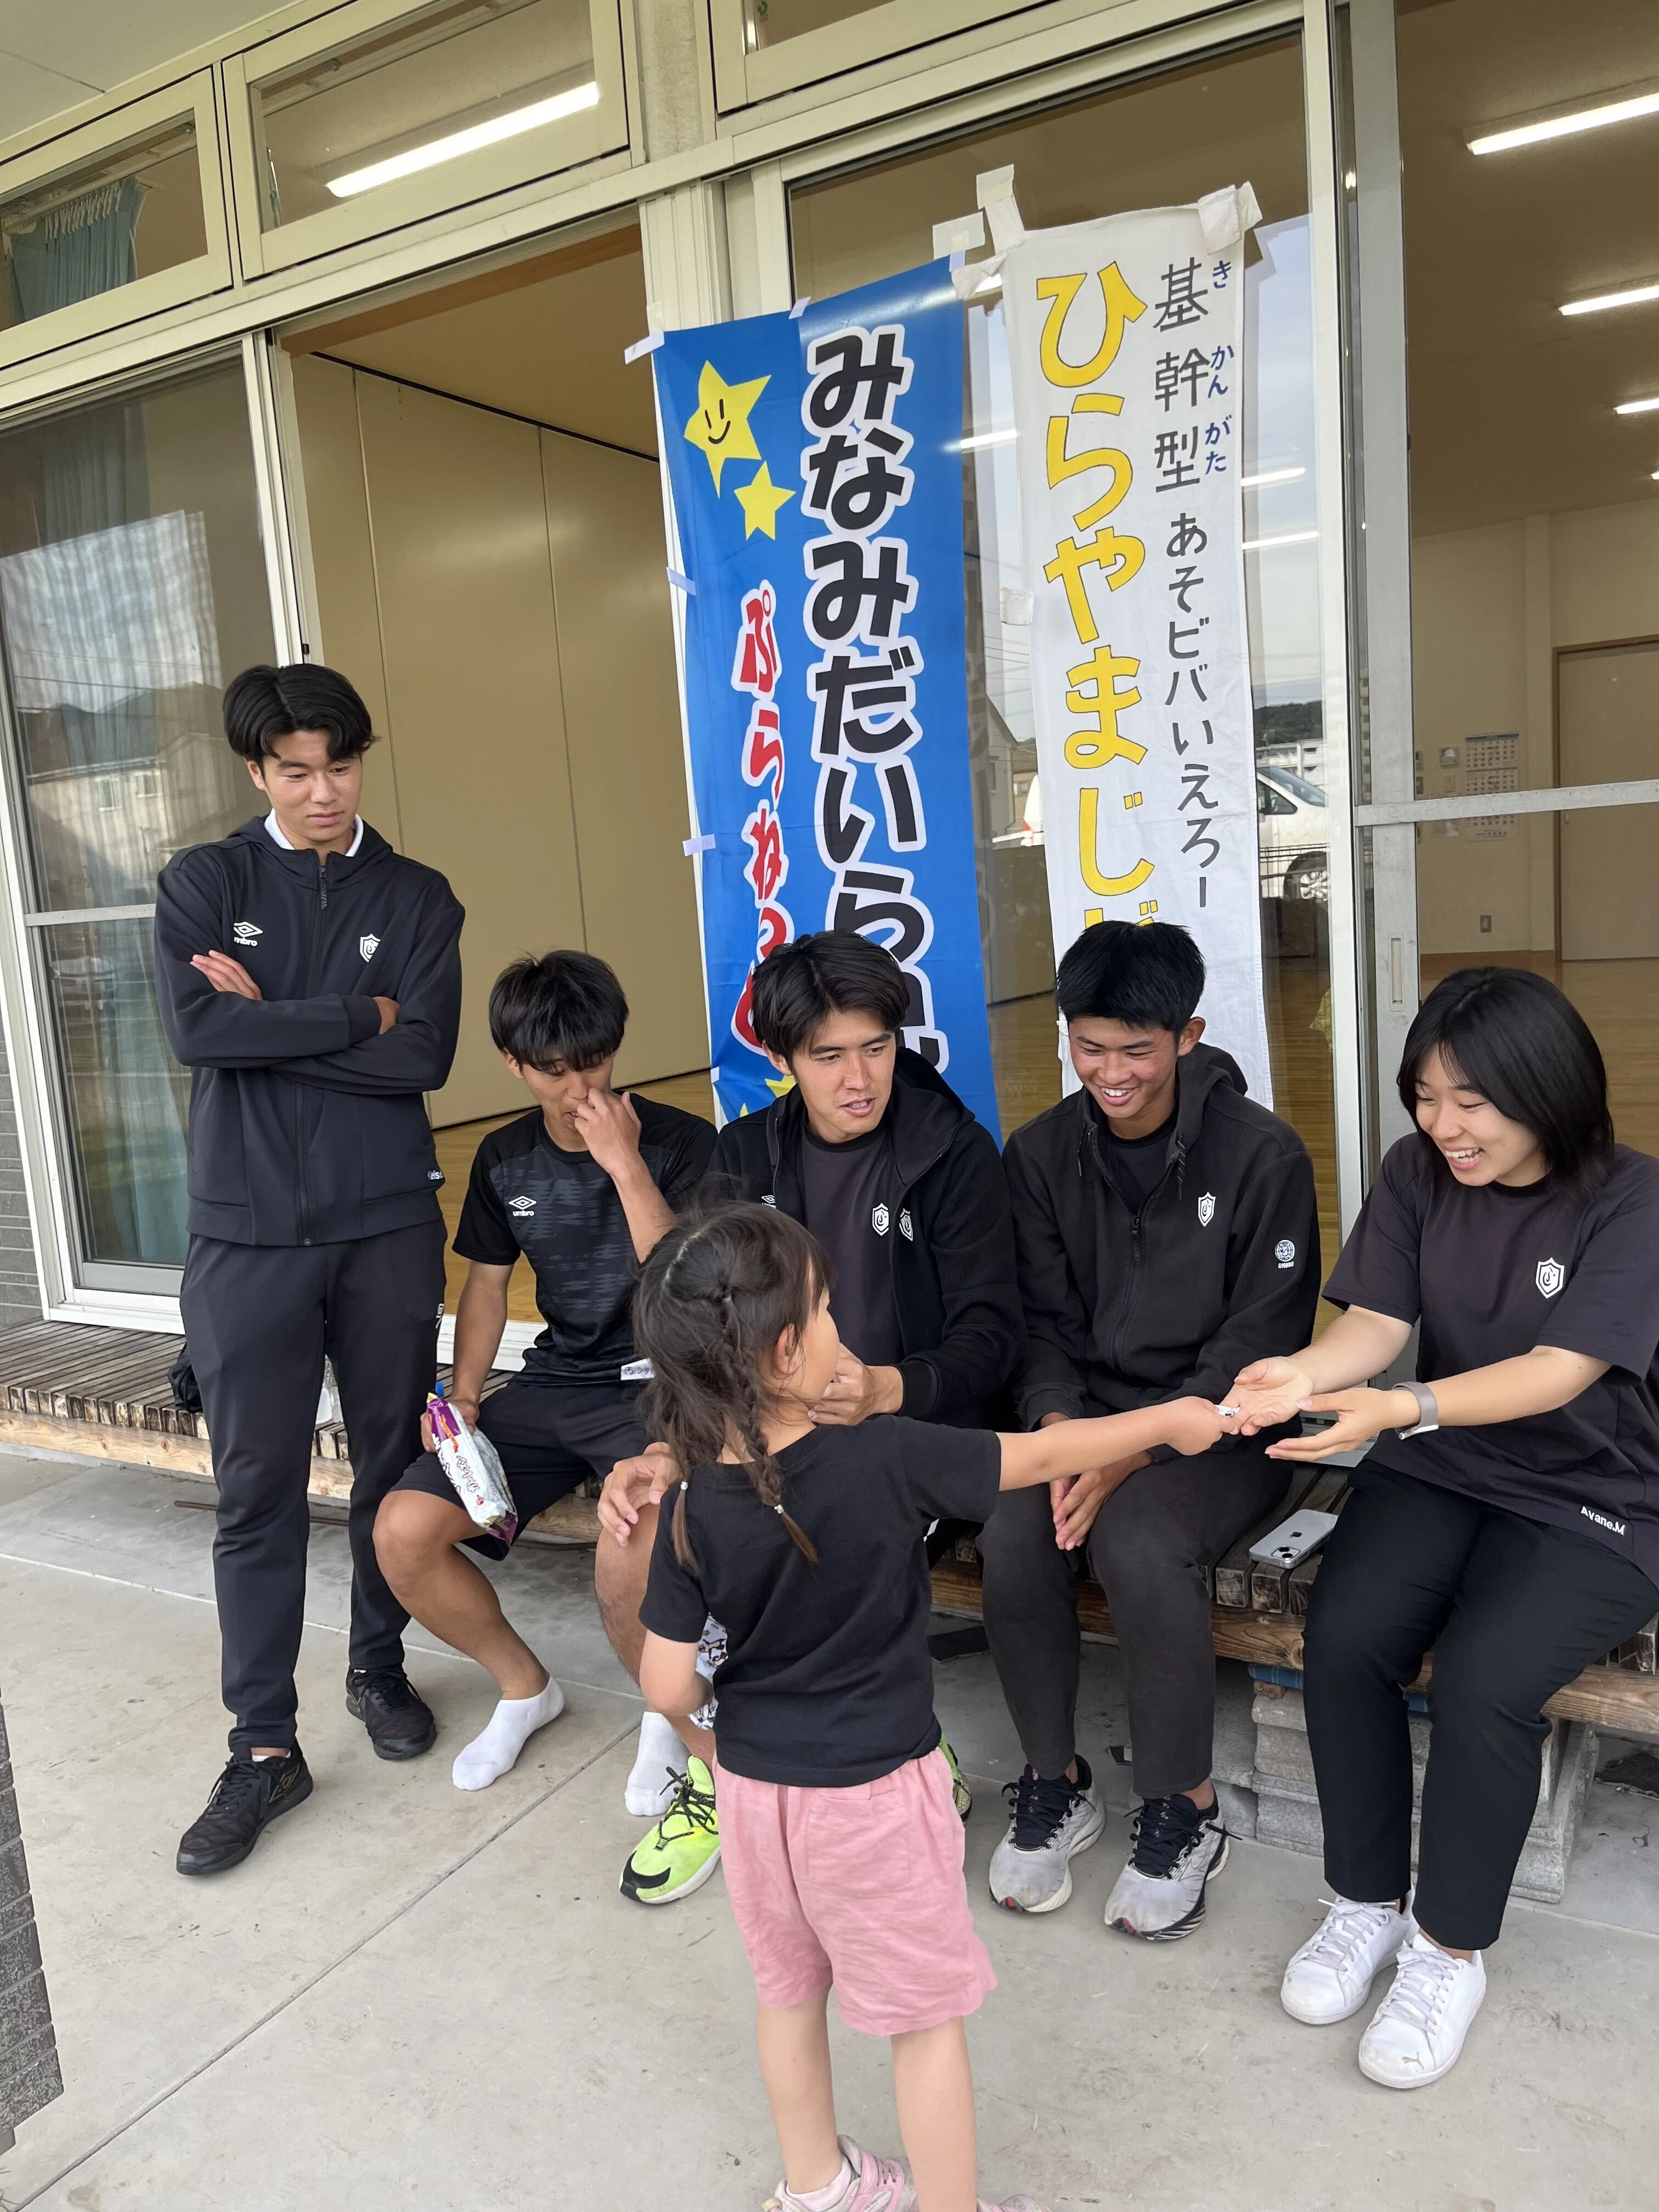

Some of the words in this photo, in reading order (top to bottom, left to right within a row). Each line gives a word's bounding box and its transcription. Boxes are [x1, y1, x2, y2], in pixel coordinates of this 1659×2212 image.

[1036, 261, 1158, 927] ひらやまじ
[234, 936, 258, 946] mbro
